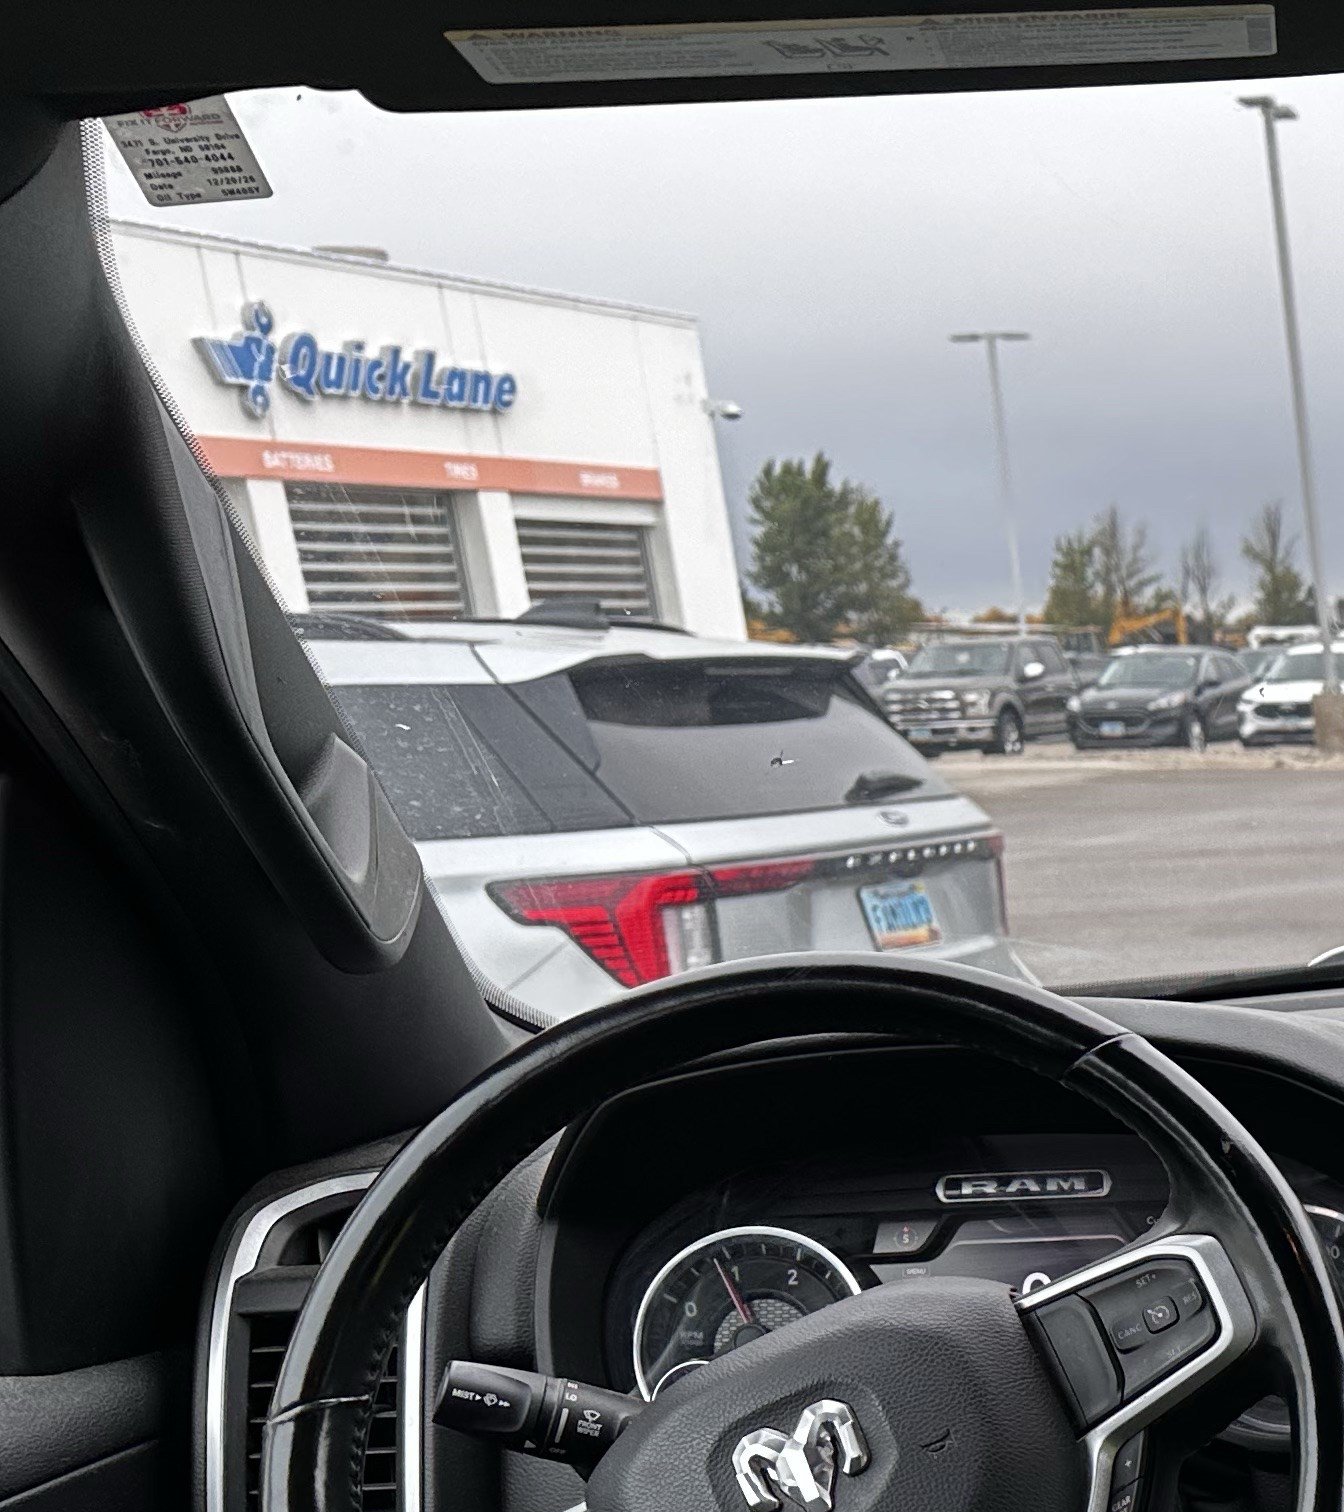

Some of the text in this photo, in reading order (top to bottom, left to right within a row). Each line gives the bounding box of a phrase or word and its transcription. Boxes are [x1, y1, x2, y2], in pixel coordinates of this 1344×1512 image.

[163, 135, 210, 145] University
[215, 133, 240, 141] Drive
[144, 170, 183, 181] Mileage
[150, 183, 174, 191] Date
[177, 192, 202, 201] Type
[960, 1176, 1086, 1196] RAM
[730, 1266, 740, 1283] 1
[787, 1269, 799, 1286] 2
[685, 1302, 698, 1317] 0
[452, 1388, 475, 1400] MIST
